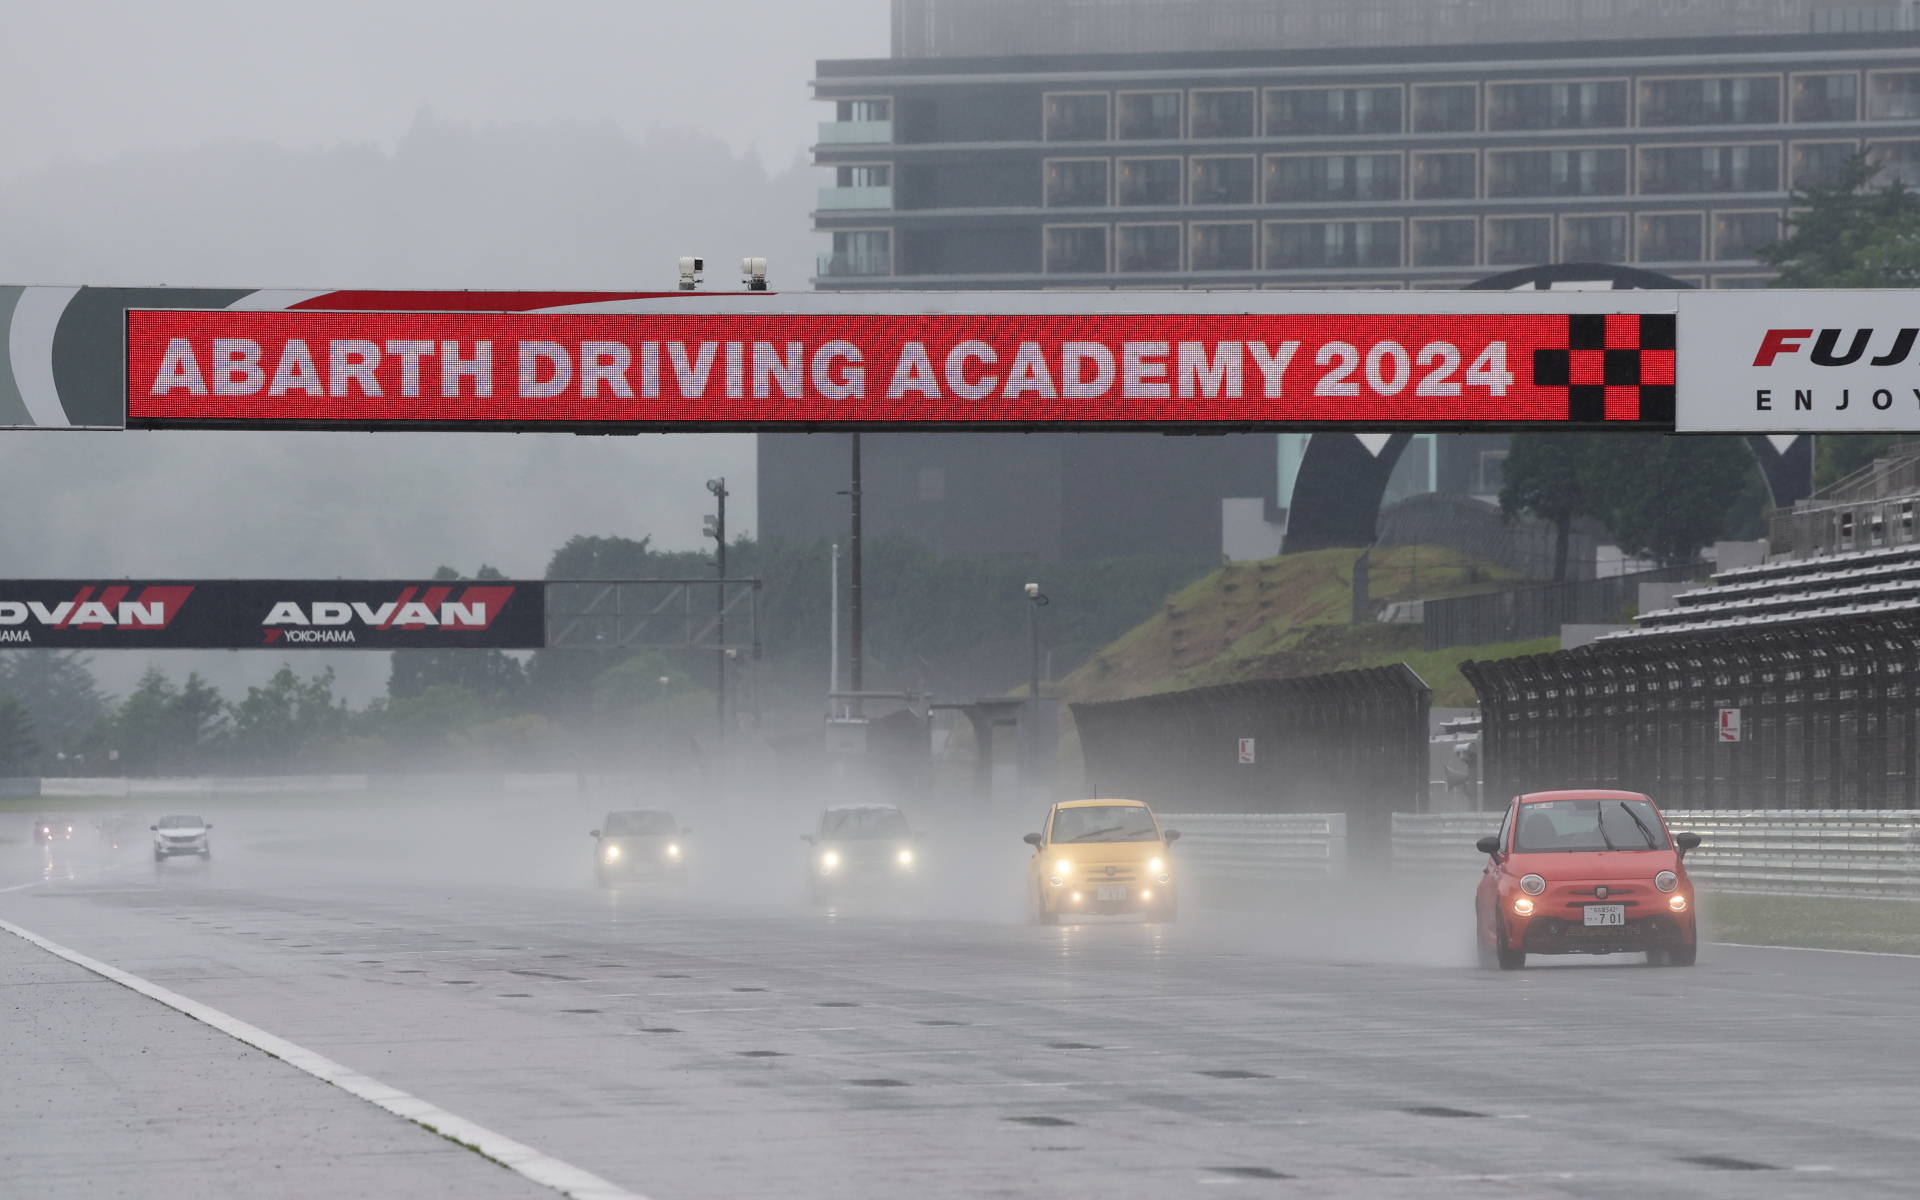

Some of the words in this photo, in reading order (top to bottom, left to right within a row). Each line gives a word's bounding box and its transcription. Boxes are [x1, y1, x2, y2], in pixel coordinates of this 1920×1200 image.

[1752, 328, 1920, 367] FUJ
[150, 337, 493, 398] ABARTH
[518, 339, 865, 400] DRIVING
[886, 339, 1301, 400] ACADEMY
[1313, 340, 1515, 397] 2024
[261, 601, 486, 625] ADVAN
[0, 630, 32, 642] AMA
[284, 630, 355, 643] YOKOHAMA
